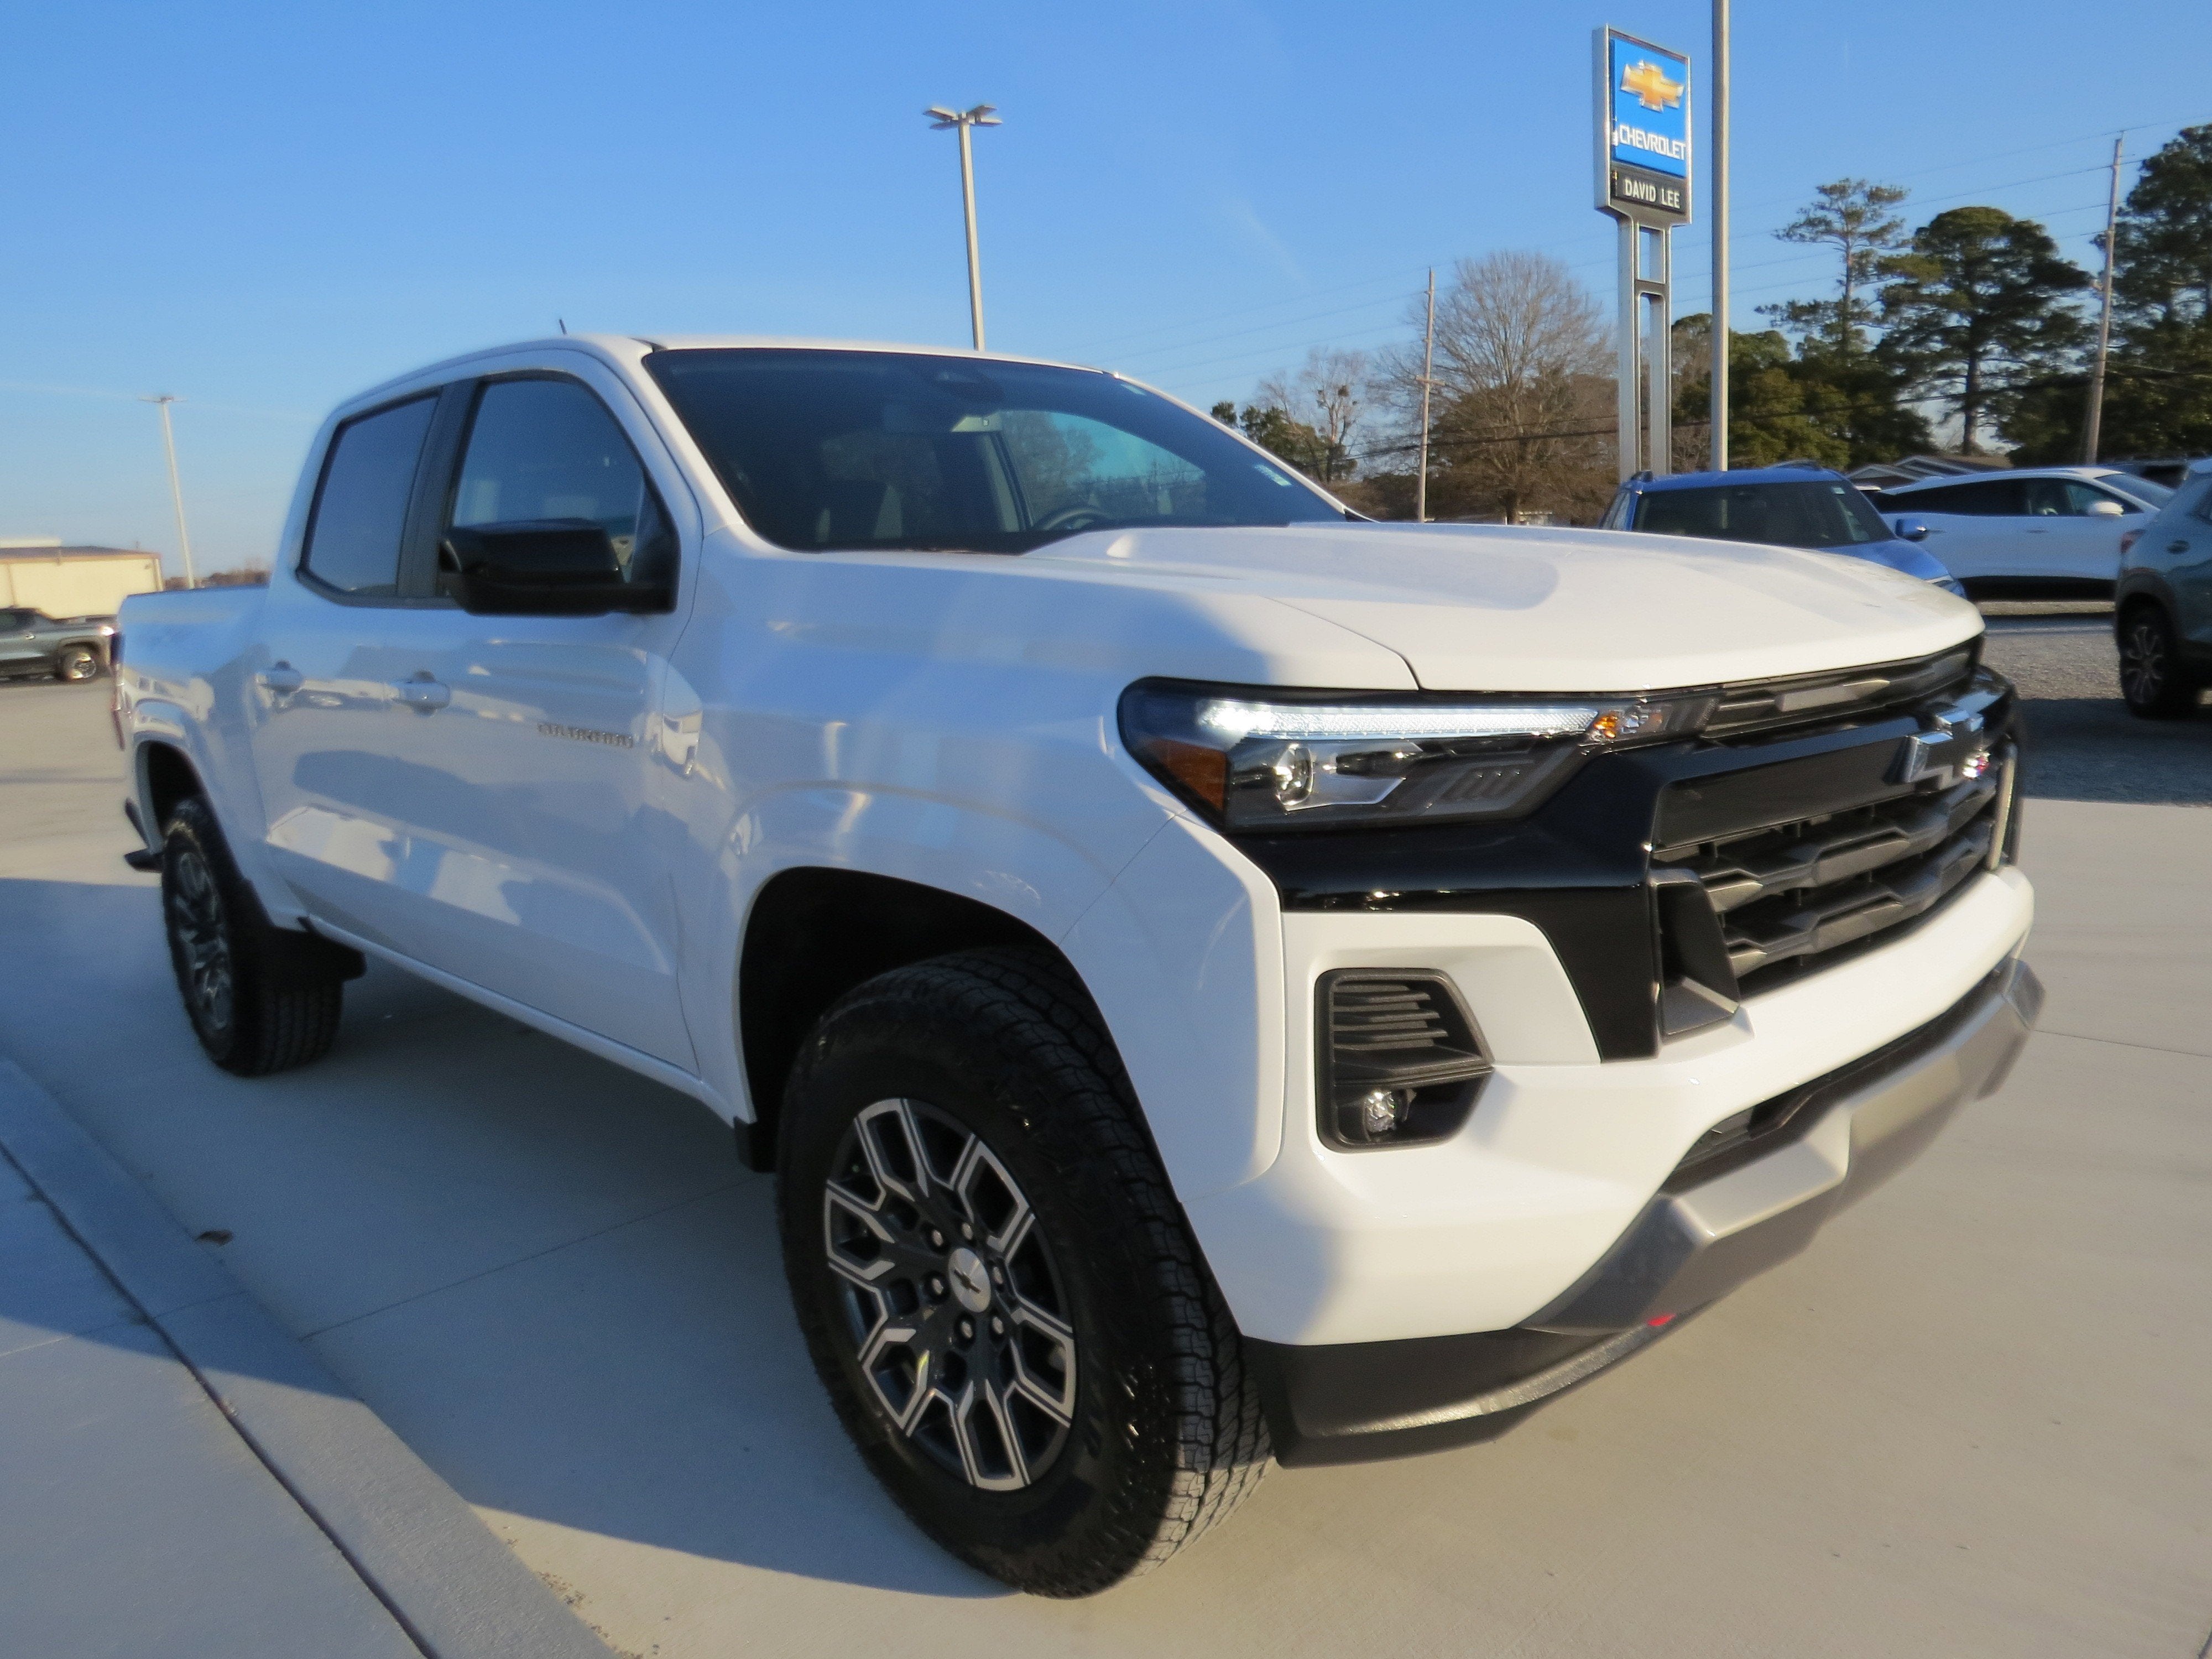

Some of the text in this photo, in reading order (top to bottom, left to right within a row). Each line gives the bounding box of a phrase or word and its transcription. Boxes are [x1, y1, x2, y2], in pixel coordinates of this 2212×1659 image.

[1620, 124, 1686, 160] CHEVROLET
[1625, 178, 1680, 208] DAVID LEE
